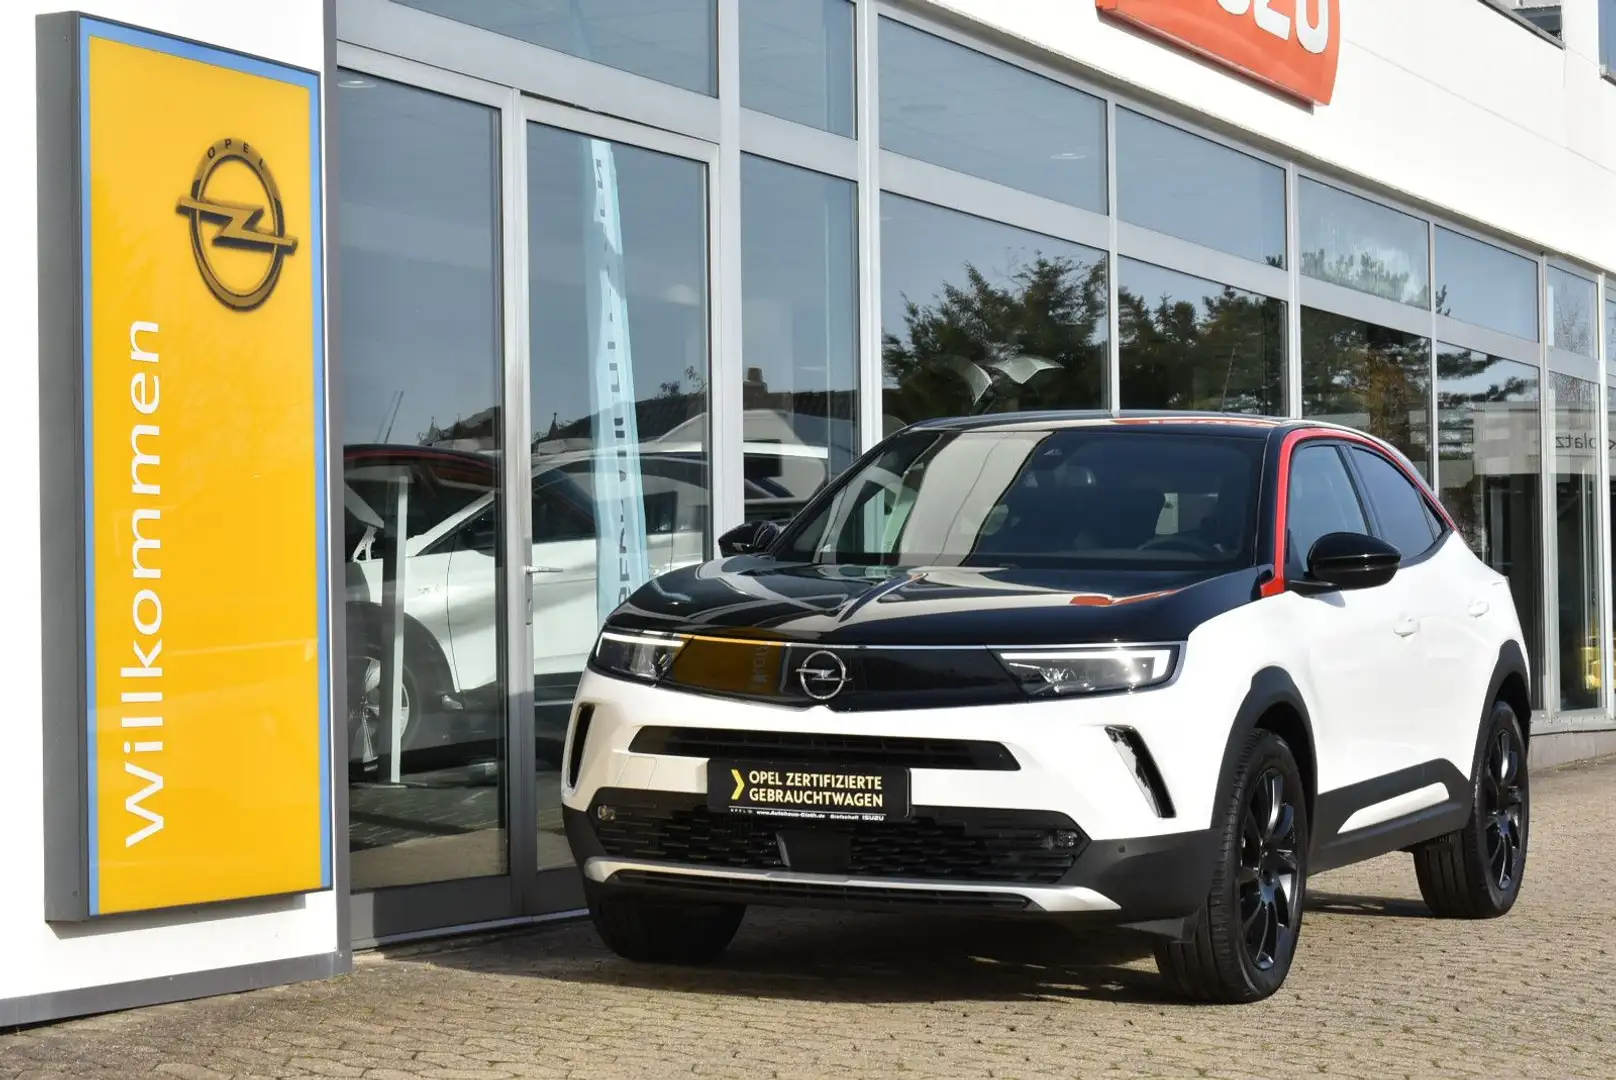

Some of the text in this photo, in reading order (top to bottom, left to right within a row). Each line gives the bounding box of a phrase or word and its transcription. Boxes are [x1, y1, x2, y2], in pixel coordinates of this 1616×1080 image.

[206, 138, 266, 169] OPEL
[120, 319, 164, 848] Willkommen
[749, 770, 882, 790] OPEL ZERTIFIZIERTE
[749, 787, 883, 807] GEBRAUCHTWAGEN
[861, 814, 884, 822] ISUZU
